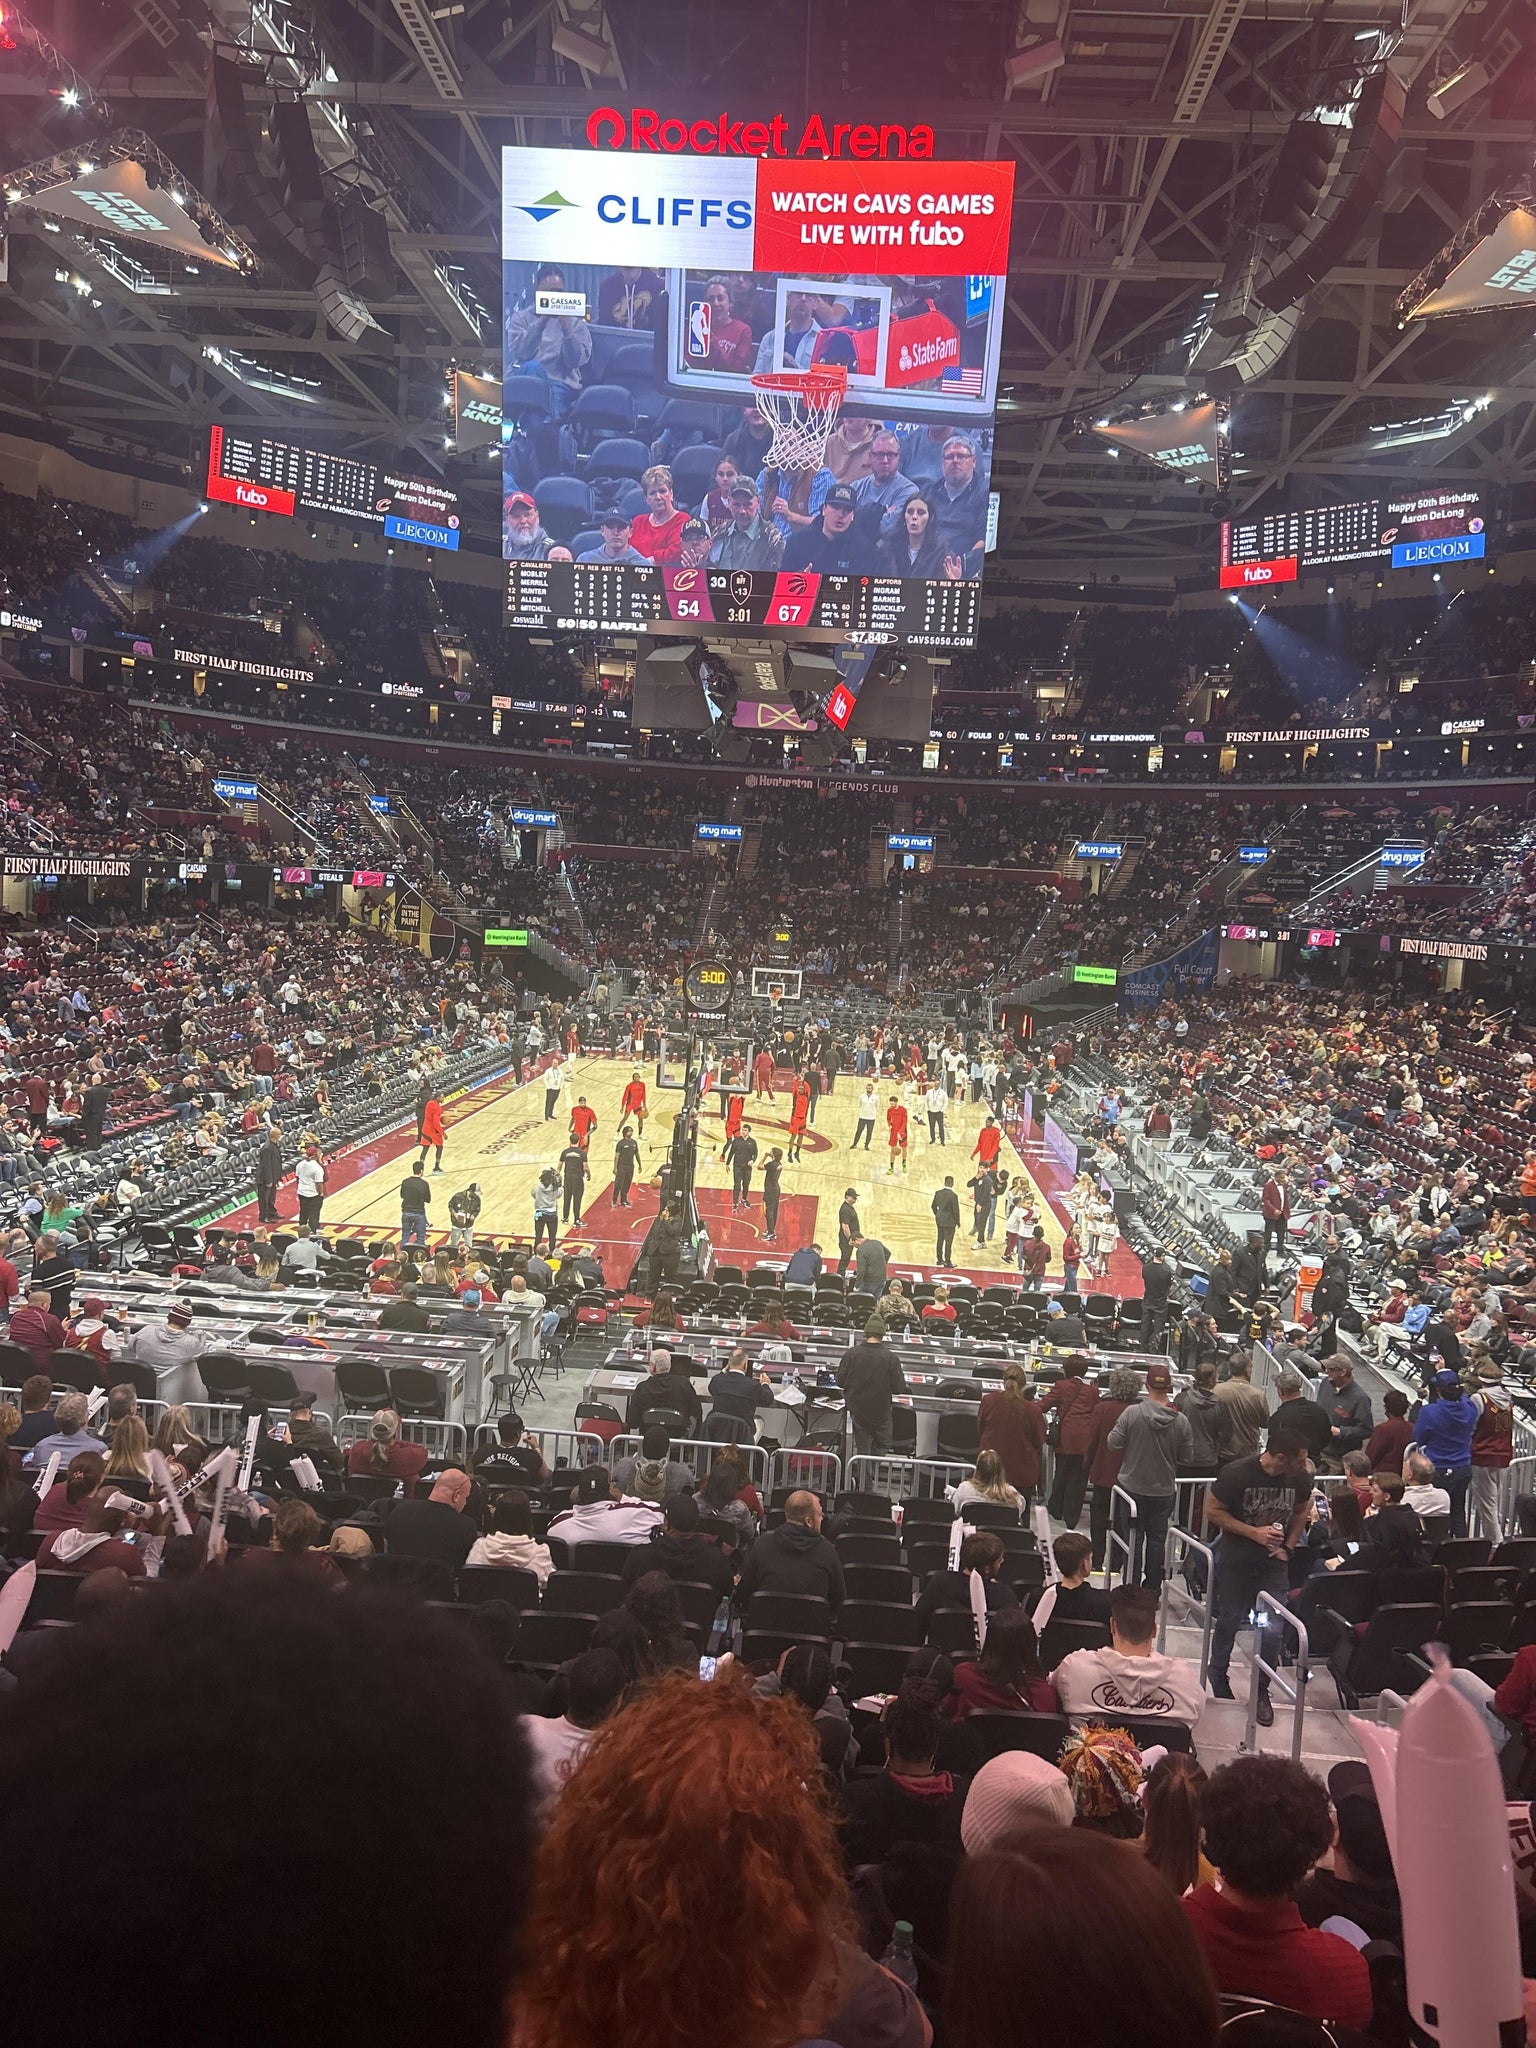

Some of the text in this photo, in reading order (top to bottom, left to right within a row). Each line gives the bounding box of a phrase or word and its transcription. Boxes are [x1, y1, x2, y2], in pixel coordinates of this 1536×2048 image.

[632, 107, 934, 158] Rocket Arena
[772, 191, 994, 216] WATCH CAVS GAMES
[597, 194, 752, 229] CLIFFS
[801, 220, 964, 246] LIVE WITH fubo
[550, 298, 582, 306] CAESARS
[461, 409, 503, 426] KNO
[236, 486, 268, 505] fubo
[384, 476, 457, 501] Happy 50th Birthday,
[394, 491, 446, 511] Aaron DeLong
[1388, 492, 1479, 515] Happy 50th Birthday,
[305, 500, 322, 508] LOOK
[373, 514, 384, 522] FOR
[1401, 508, 1464, 524] Aaron DeLong
[1244, 566, 1272, 582] fubo
[710, 576, 727, 588] 3Q
[734, 588, 748, 596] -13
[873, 587, 900, 595] INGRAM
[873, 596, 901, 604] BARNES
[677, 600, 700, 617] 54
[728, 608, 751, 622] 3:01
[778, 604, 802, 622] 67
[872, 604, 906, 612] QUICKLEY
[12, 613, 42, 628] CAESARS
[513, 615, 544, 625] oswald
[601, 621, 648, 631] RAFFLE
[851, 631, 888, 644] $7,849
[907, 635, 974, 646] CAVS5050.COM
[174, 648, 314, 683] FIRST HALF HIGHLIGHTS
[393, 684, 423, 695] CAESARS
[514, 700, 536, 708] oswald
[545, 703, 567, 713] $7,849
[591, 708, 603, 717] -13
[612, 710, 627, 719] TOL
[833, 692, 847, 720] fubo
[1452, 719, 1485, 729] CAESARS
[946, 731, 957, 739] 60
[968, 731, 992, 740] FOULS
[998, 732, 1004, 740] 0
[1035, 733, 1041, 741] 5
[1125, 734, 1156, 742] KNOW.
[1225, 727, 1370, 742] FIRST HALF HIGHLIGHTS
[214, 781, 258, 796] drug mart
[872, 784, 899, 793] CLUB
[514, 811, 556, 824] drug mart
[699, 825, 741, 837] drug mart
[889, 836, 933, 848] drug mart
[1078, 844, 1121, 856] drug mart
[1382, 851, 1425, 863] drug mart
[4, 857, 130, 876] FIRST HALF HIGHLIGHTS
[187, 863, 208, 873] CAESARS
[300, 871, 363, 884] 3 STEALS 5
[401, 918, 419, 927] PAINT
[775, 933, 789, 941] 3:00
[1245, 929, 1320, 943] 54 3:01 67
[1400, 938, 1488, 961] FIRST HALF HIGHLIGHTS
[1174, 964, 1213, 975] Full Court
[701, 971, 725, 984] 3:00
[1180, 975, 1206, 984] Poer
[1125, 982, 1160, 990] COMCAST
